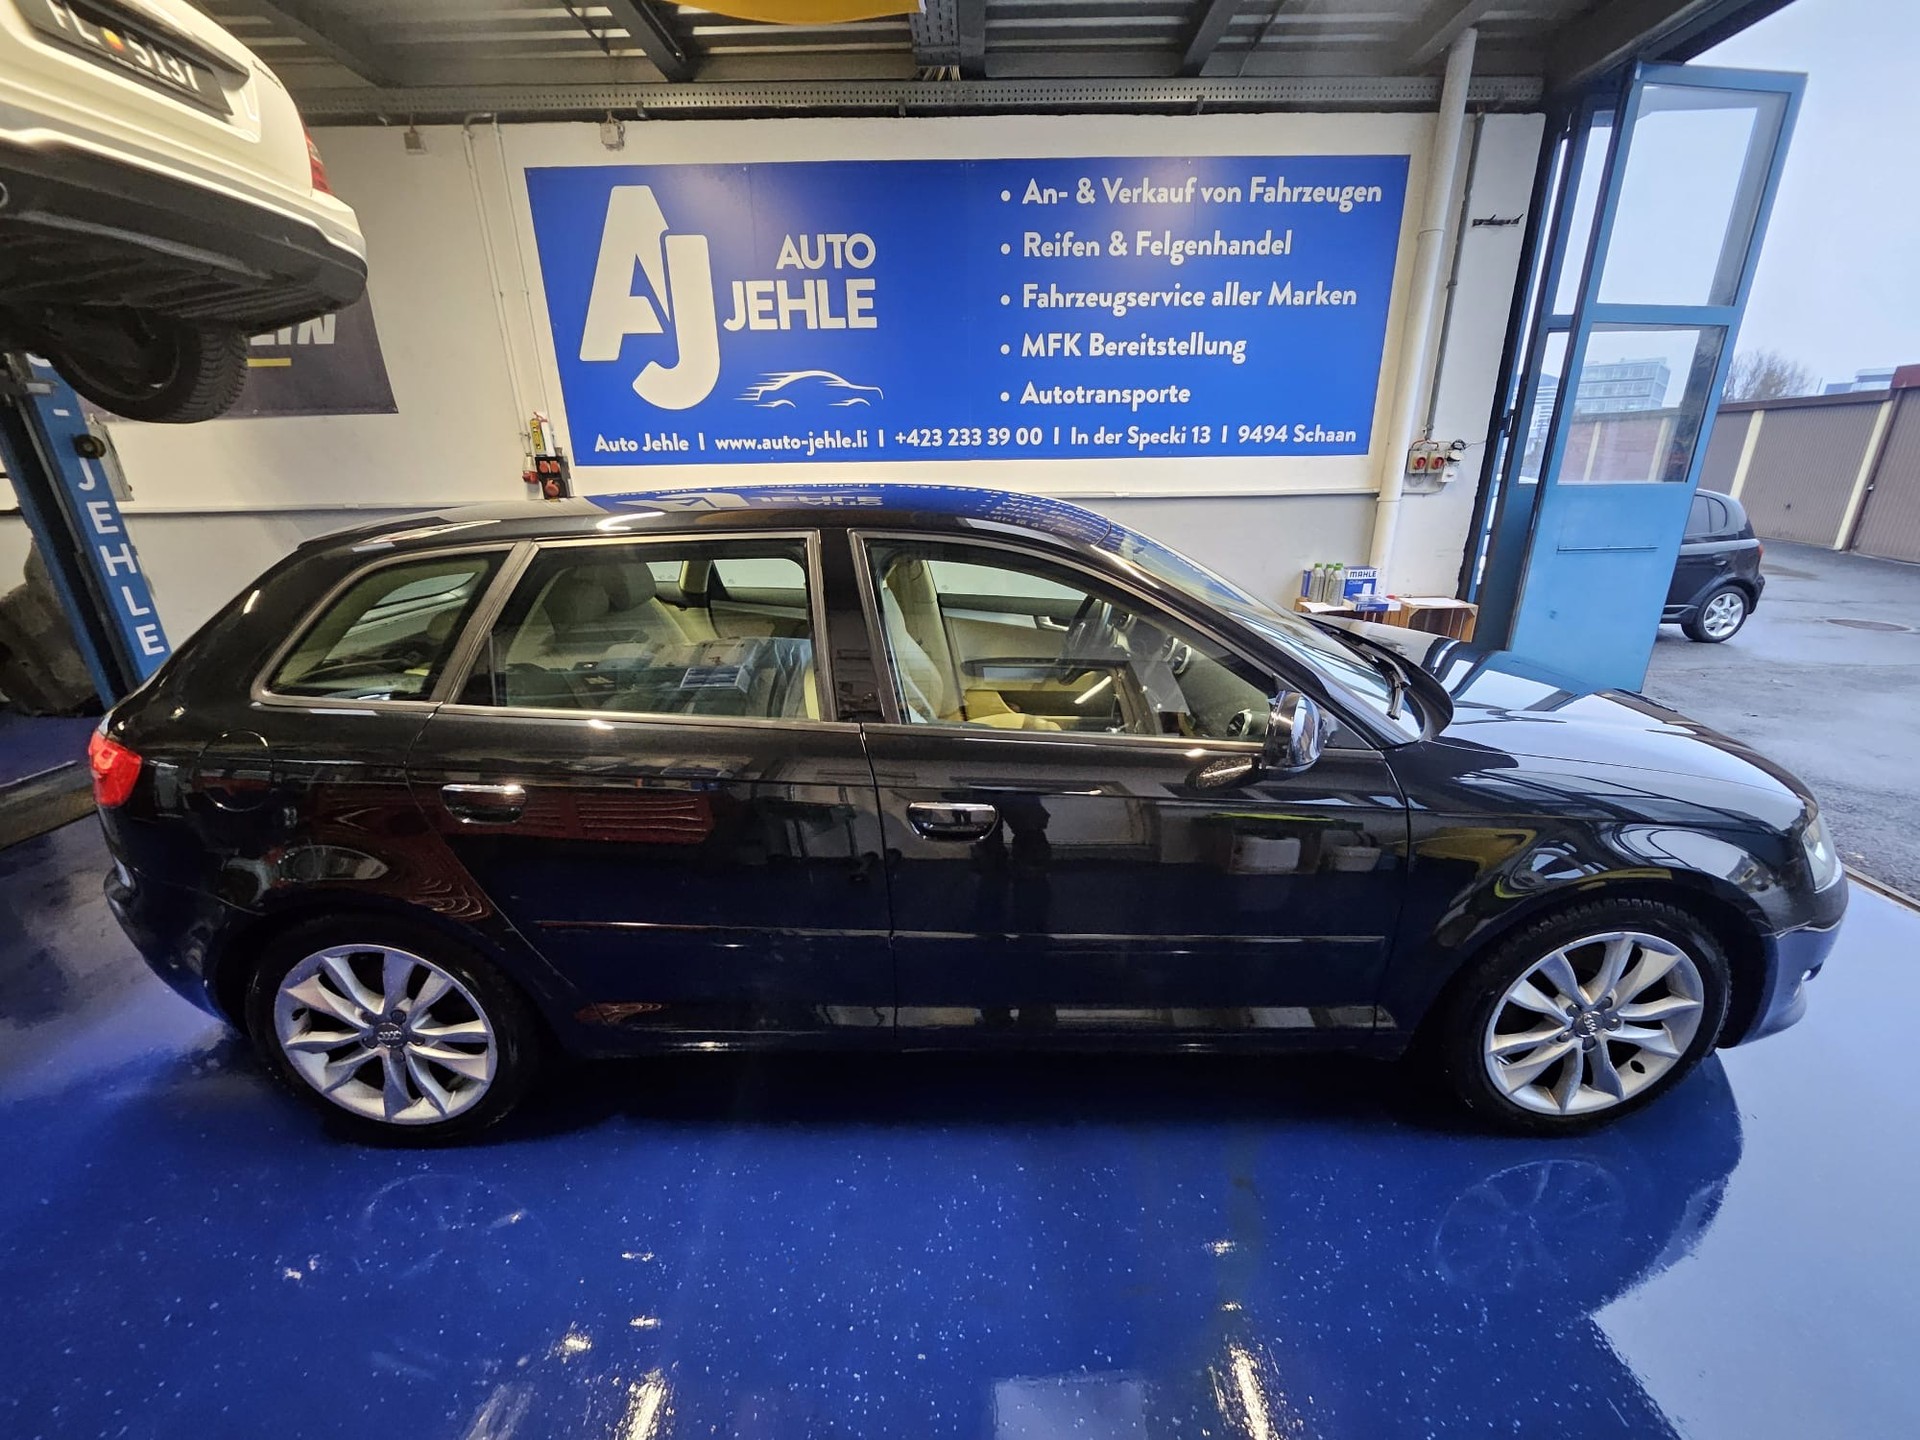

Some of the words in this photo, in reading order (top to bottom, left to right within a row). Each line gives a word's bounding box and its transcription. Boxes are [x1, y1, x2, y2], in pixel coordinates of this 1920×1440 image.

[1022, 178, 1068, 204] An-
[1076, 177, 1096, 204] &
[1102, 177, 1197, 204] Verkauf
[1201, 186, 1242, 203] von
[1249, 176, 1382, 213] Fahrzeugen
[775, 233, 876, 270] AUTO
[1023, 231, 1100, 257] Reifen
[1108, 230, 1128, 257] &
[1136, 229, 1292, 266] Felgenhandel
[579, 184, 721, 410] AJ
[723, 278, 878, 332] JEHLE
[1023, 282, 1206, 317] Fahrzeugservice
[1211, 281, 1263, 307] aller
[1268, 280, 1357, 306] Marken
[1021, 332, 1082, 357] MFK
[1089, 331, 1247, 365] Bereitstellung
[1020, 381, 1191, 412] Autotransporte
[594, 434, 639, 452] Auto
[642, 432, 689, 451] Jehle
[715, 429, 868, 456] www.auto-jehle.li
[895, 428, 943, 447] +423
[947, 427, 982, 446] 233
[987, 427, 1011, 446] 39
[1016, 427, 1043, 446] 00
[1071, 426, 1089, 445] In
[1094, 426, 1123, 445] der
[1127, 425, 1187, 451] Specki
[1191, 425, 1211, 444] 13
[1238, 424, 1288, 443] 9494
[1293, 424, 1356, 443] Schaan
[78, 457, 165, 656] JEHLE
[1349, 570, 1376, 578] MAHLE
